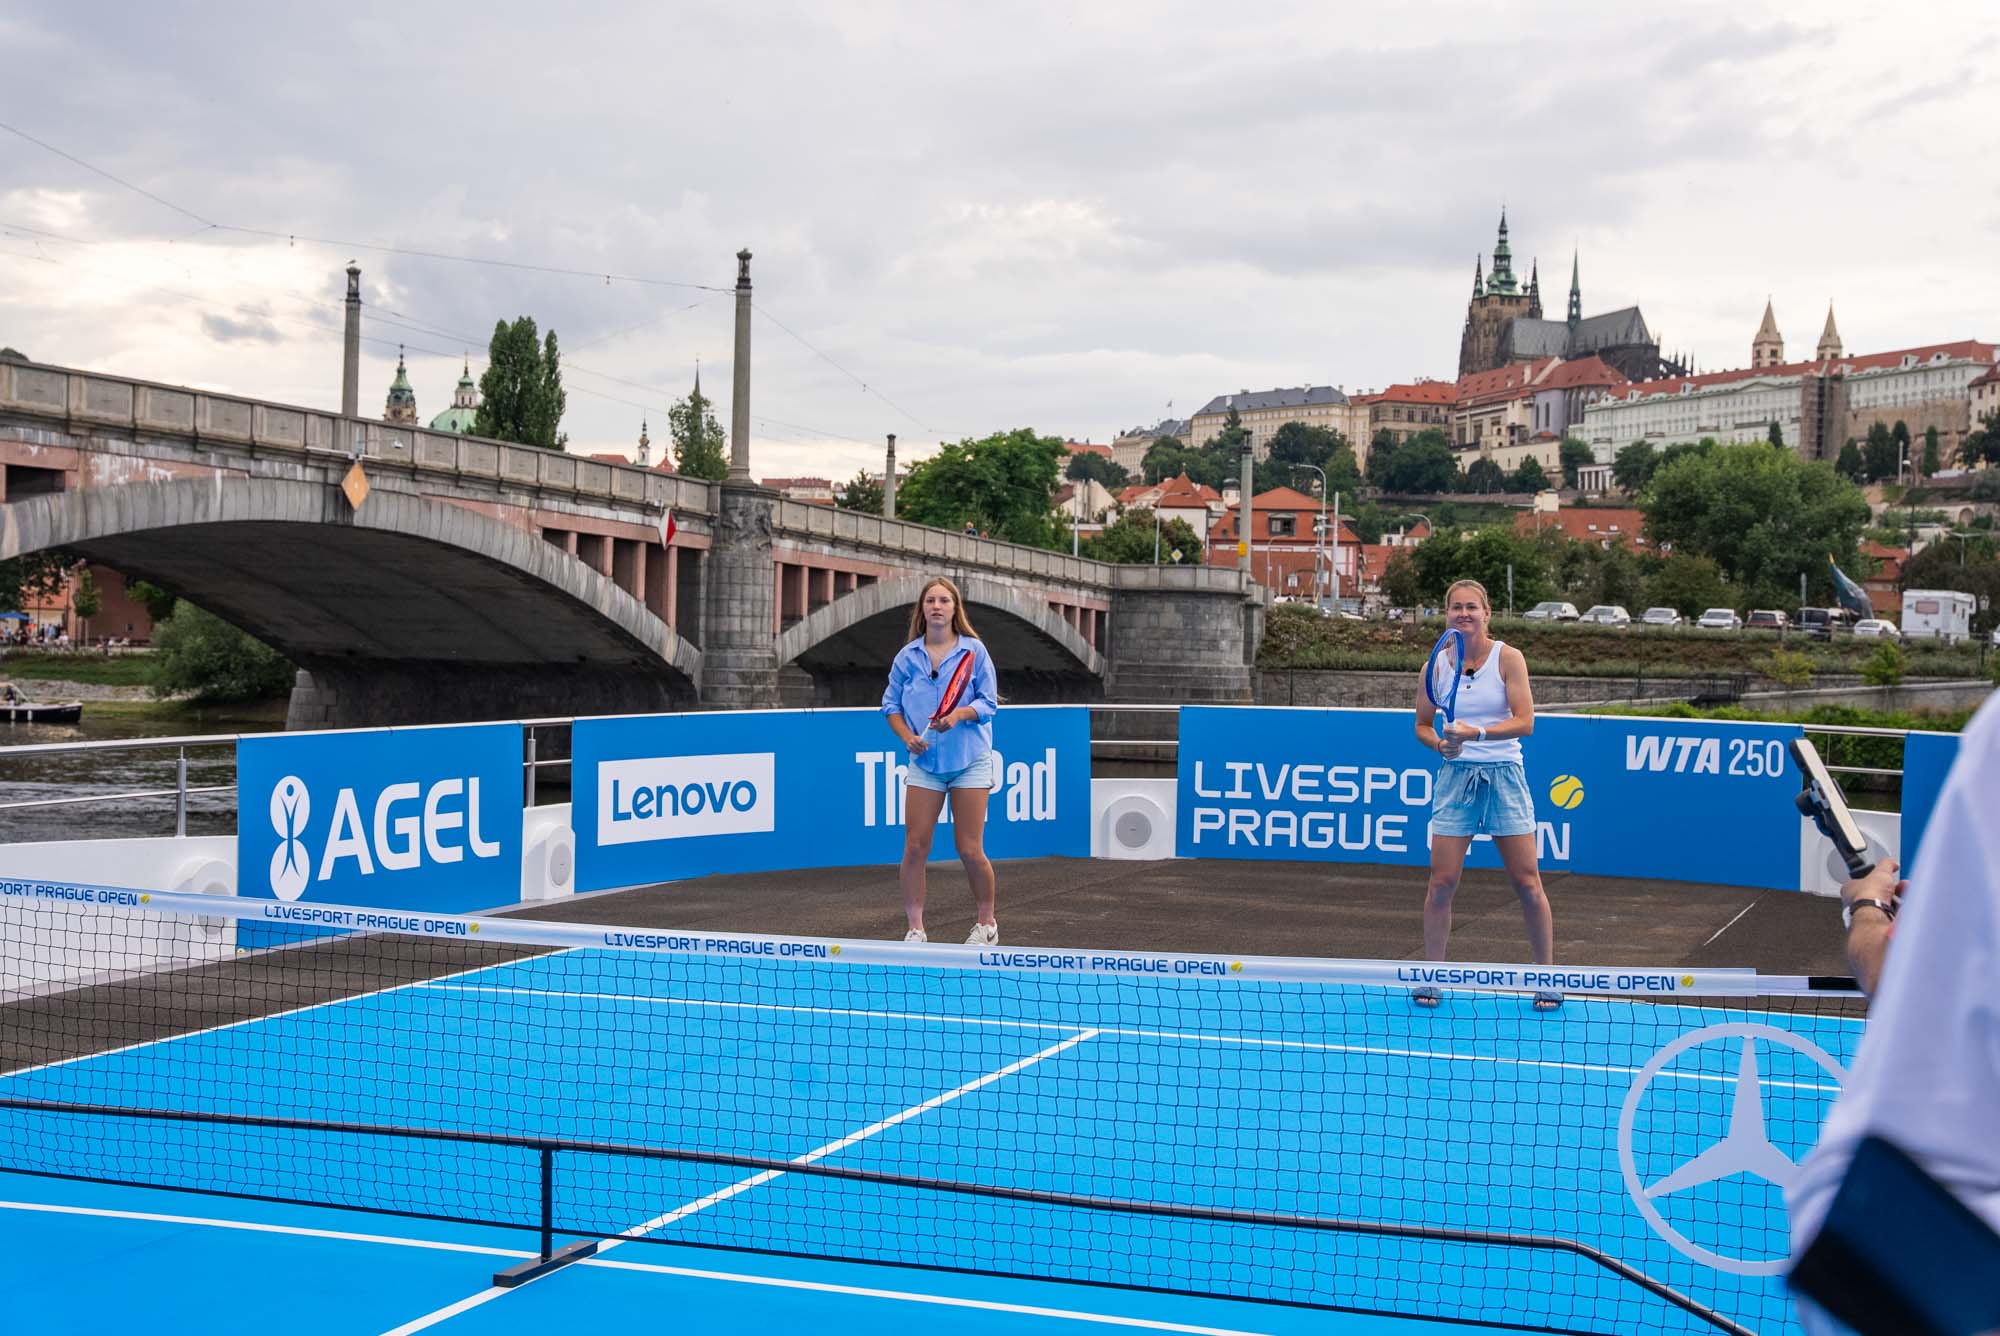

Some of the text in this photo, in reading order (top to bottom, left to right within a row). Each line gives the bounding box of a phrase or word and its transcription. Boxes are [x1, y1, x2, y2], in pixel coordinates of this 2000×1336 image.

[1626, 735, 1784, 777] WTA 250
[612, 779, 757, 822] Lenovo
[1194, 761, 1440, 807] LIVESPO
[317, 776, 500, 881] AGEL
[1193, 808, 1409, 853] PRAGUE
[35, 885, 95, 902] PRAGUE
[98, 890, 138, 906] OPEN
[264, 904, 466, 936] LIVESPORT PRAGUE OPEN
[604, 932, 827, 958] LIVESPORT PRAGUE OPEN
[979, 952, 1227, 976] LIVESPORT PRAGUE OPEN
[1397, 967, 1676, 991] LIVESPORT PRAGUE OPEN
